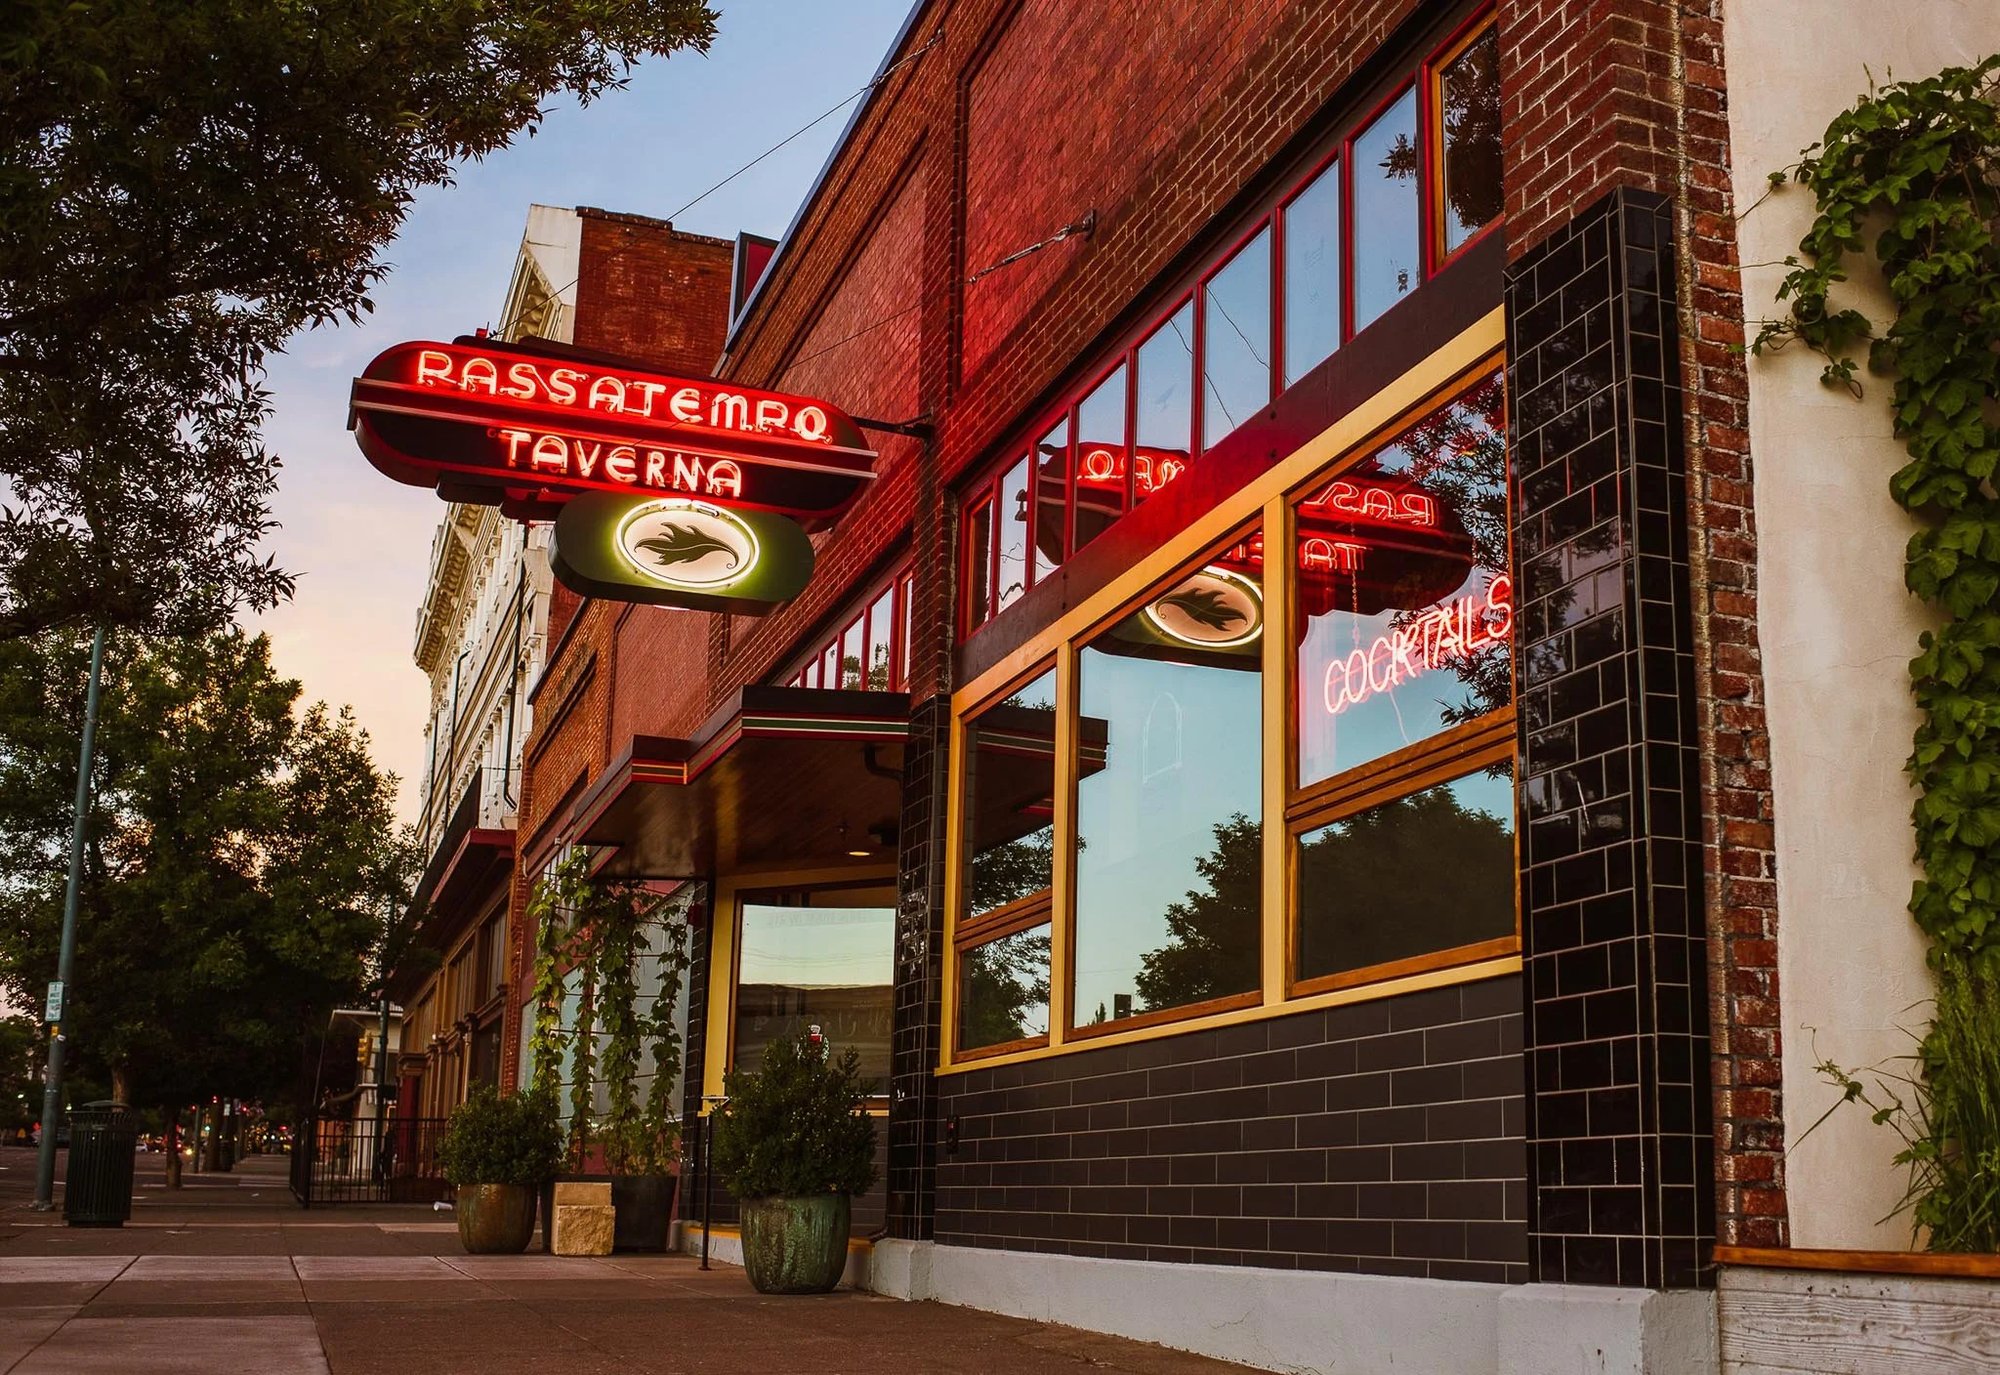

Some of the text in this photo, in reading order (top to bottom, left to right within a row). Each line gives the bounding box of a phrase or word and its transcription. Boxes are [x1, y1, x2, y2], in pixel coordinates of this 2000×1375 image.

[417, 350, 829, 442] PASSATEMPO
[498, 430, 742, 498] TAVERNA
[1323, 575, 1512, 714] COCKTAILS
